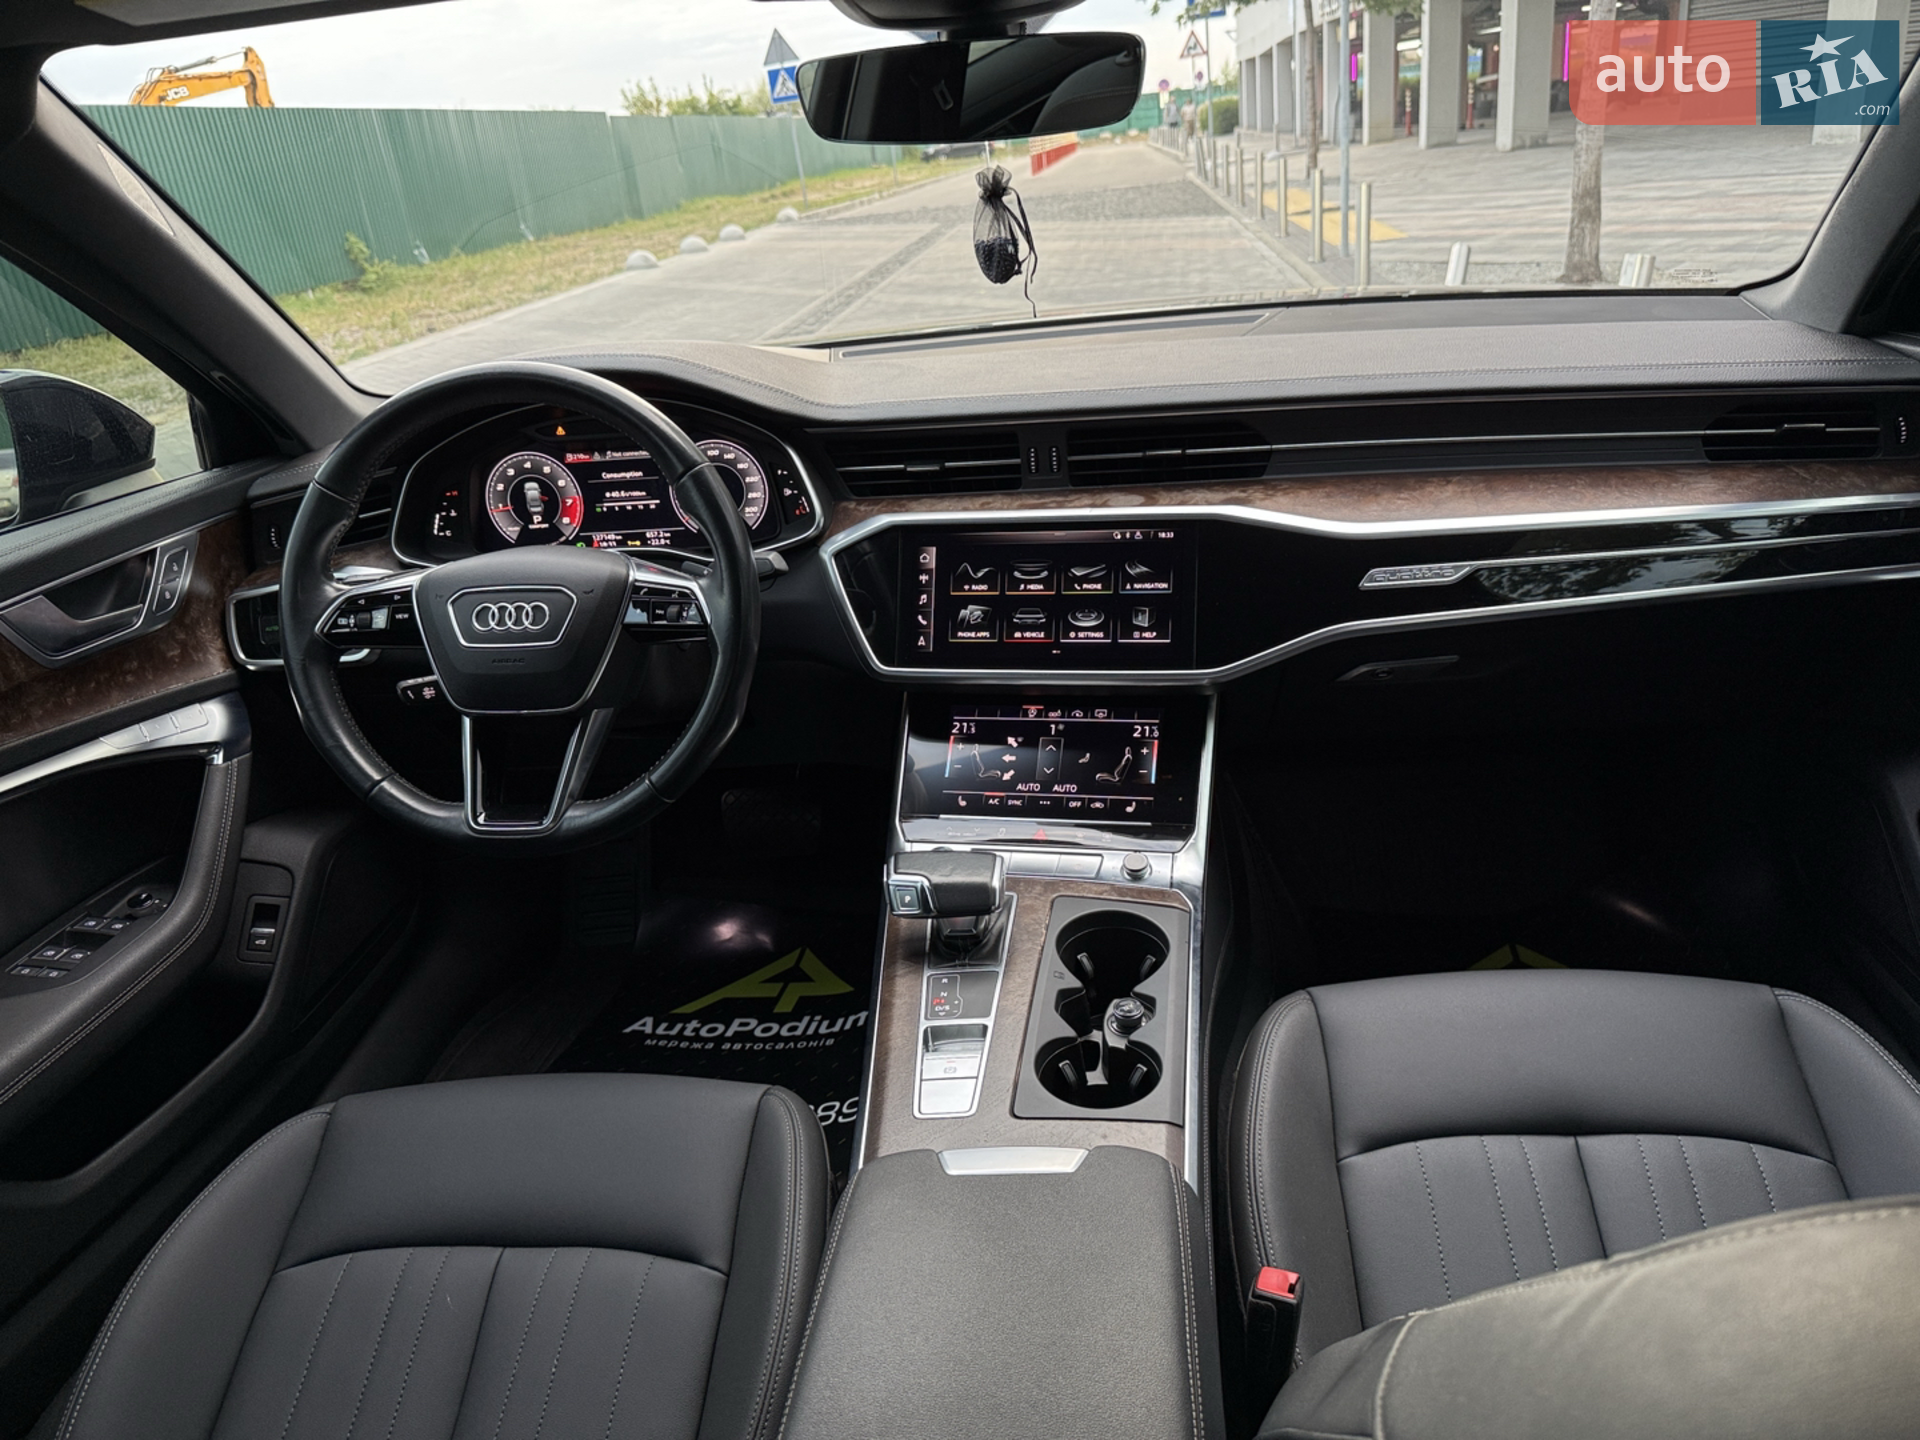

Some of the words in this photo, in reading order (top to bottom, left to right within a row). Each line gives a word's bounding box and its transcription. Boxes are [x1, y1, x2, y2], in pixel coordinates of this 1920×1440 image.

[166, 85, 190, 101] JCB
[523, 461, 532, 469] 4
[506, 467, 515, 476] 3
[601, 470, 644, 479] Consumption
[496, 483, 505, 491] 2
[565, 498, 574, 507] 7
[533, 515, 542, 525] P
[1372, 567, 1456, 583] quattro
[1133, 582, 1169, 590] NAVIGATION
[1016, 783, 1041, 792] AUTO
[1052, 784, 1078, 793] AUTO
[988, 798, 1000, 806] A/C
[904, 895, 912, 904] P
[935, 1004, 951, 1012] D/S
[644, 1039, 715, 1050] мережа
[721, 1038, 836, 1050] автосалонів
[808, 1096, 860, 1127] 89
